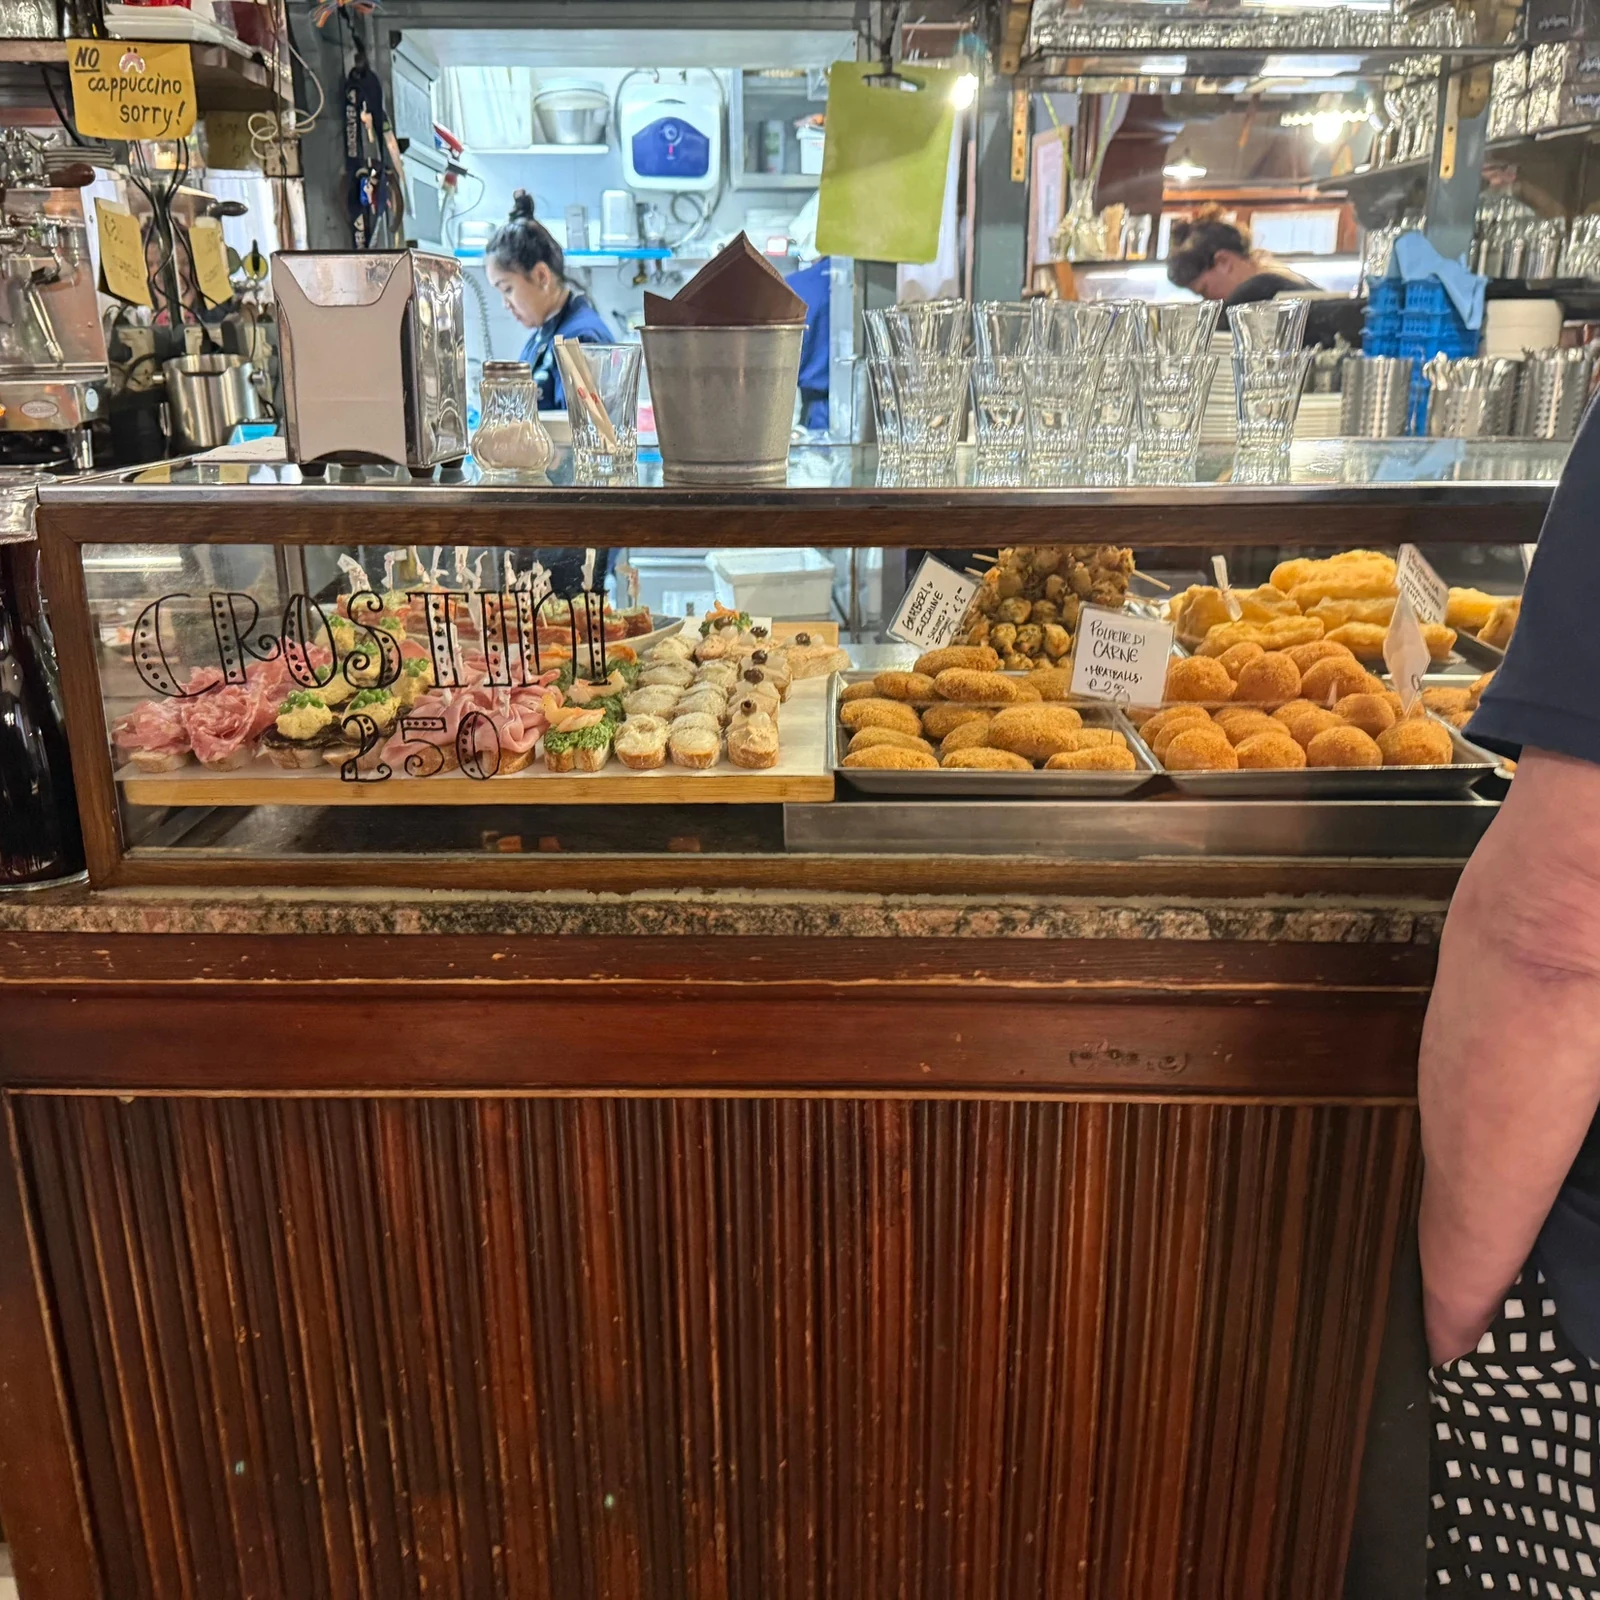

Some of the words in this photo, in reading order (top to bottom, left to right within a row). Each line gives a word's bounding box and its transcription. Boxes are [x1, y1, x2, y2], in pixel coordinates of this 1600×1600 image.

[75, 46, 100, 69] NO
[88, 73, 182, 101] cappuccino
[119, 101, 186, 137] sorry!
[131, 588, 611, 698] CROSTINI
[1093, 639, 1138, 663] CARNE
[1133, 634, 1145, 646] DI
